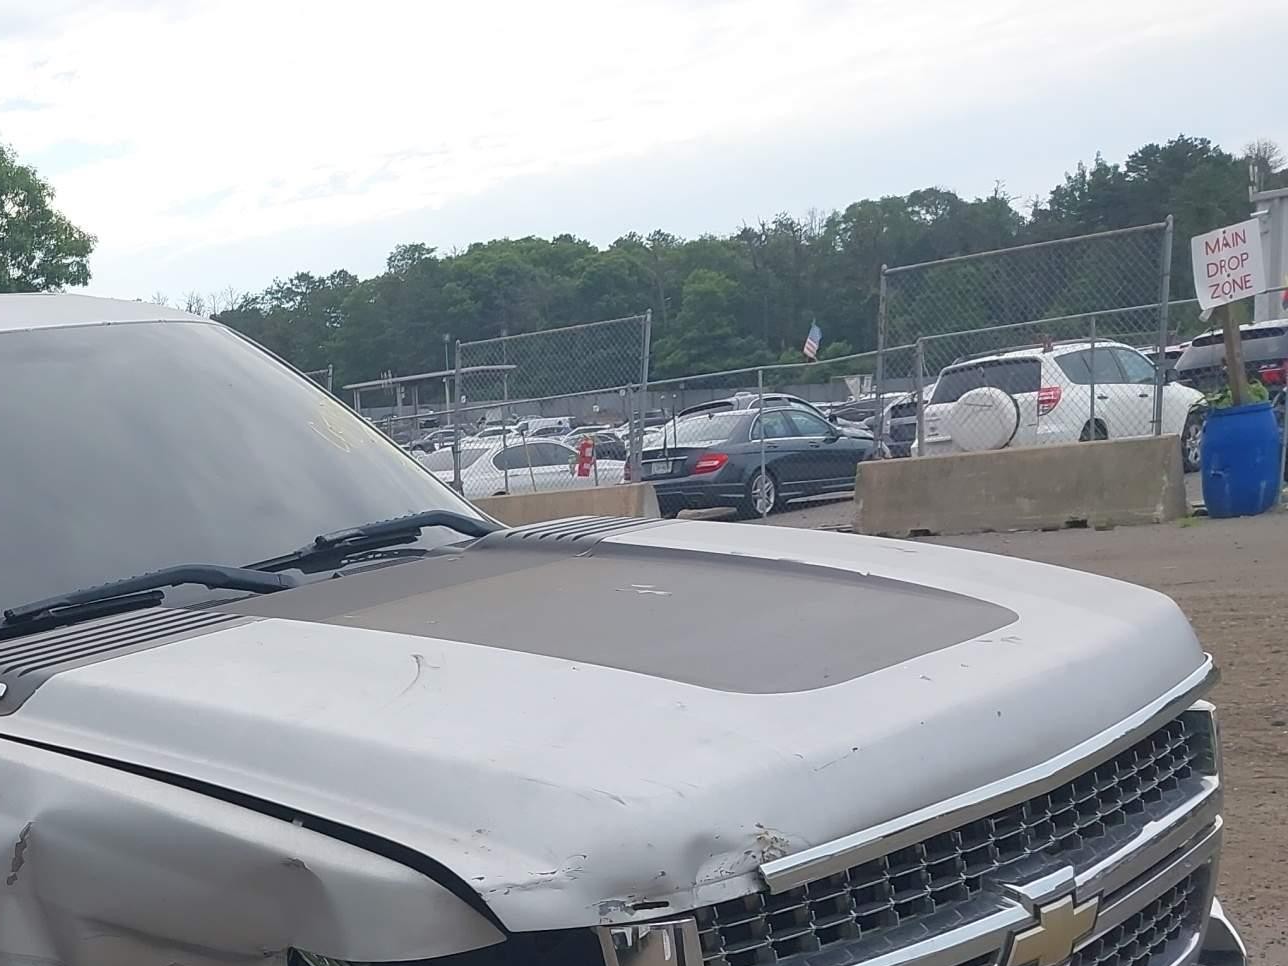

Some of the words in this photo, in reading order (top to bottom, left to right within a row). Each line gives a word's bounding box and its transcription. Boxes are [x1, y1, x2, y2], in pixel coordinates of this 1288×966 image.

[1205, 228, 1247, 256] MAIN
[1206, 252, 1249, 278] DROP
[1208, 273, 1253, 300] ZONE
